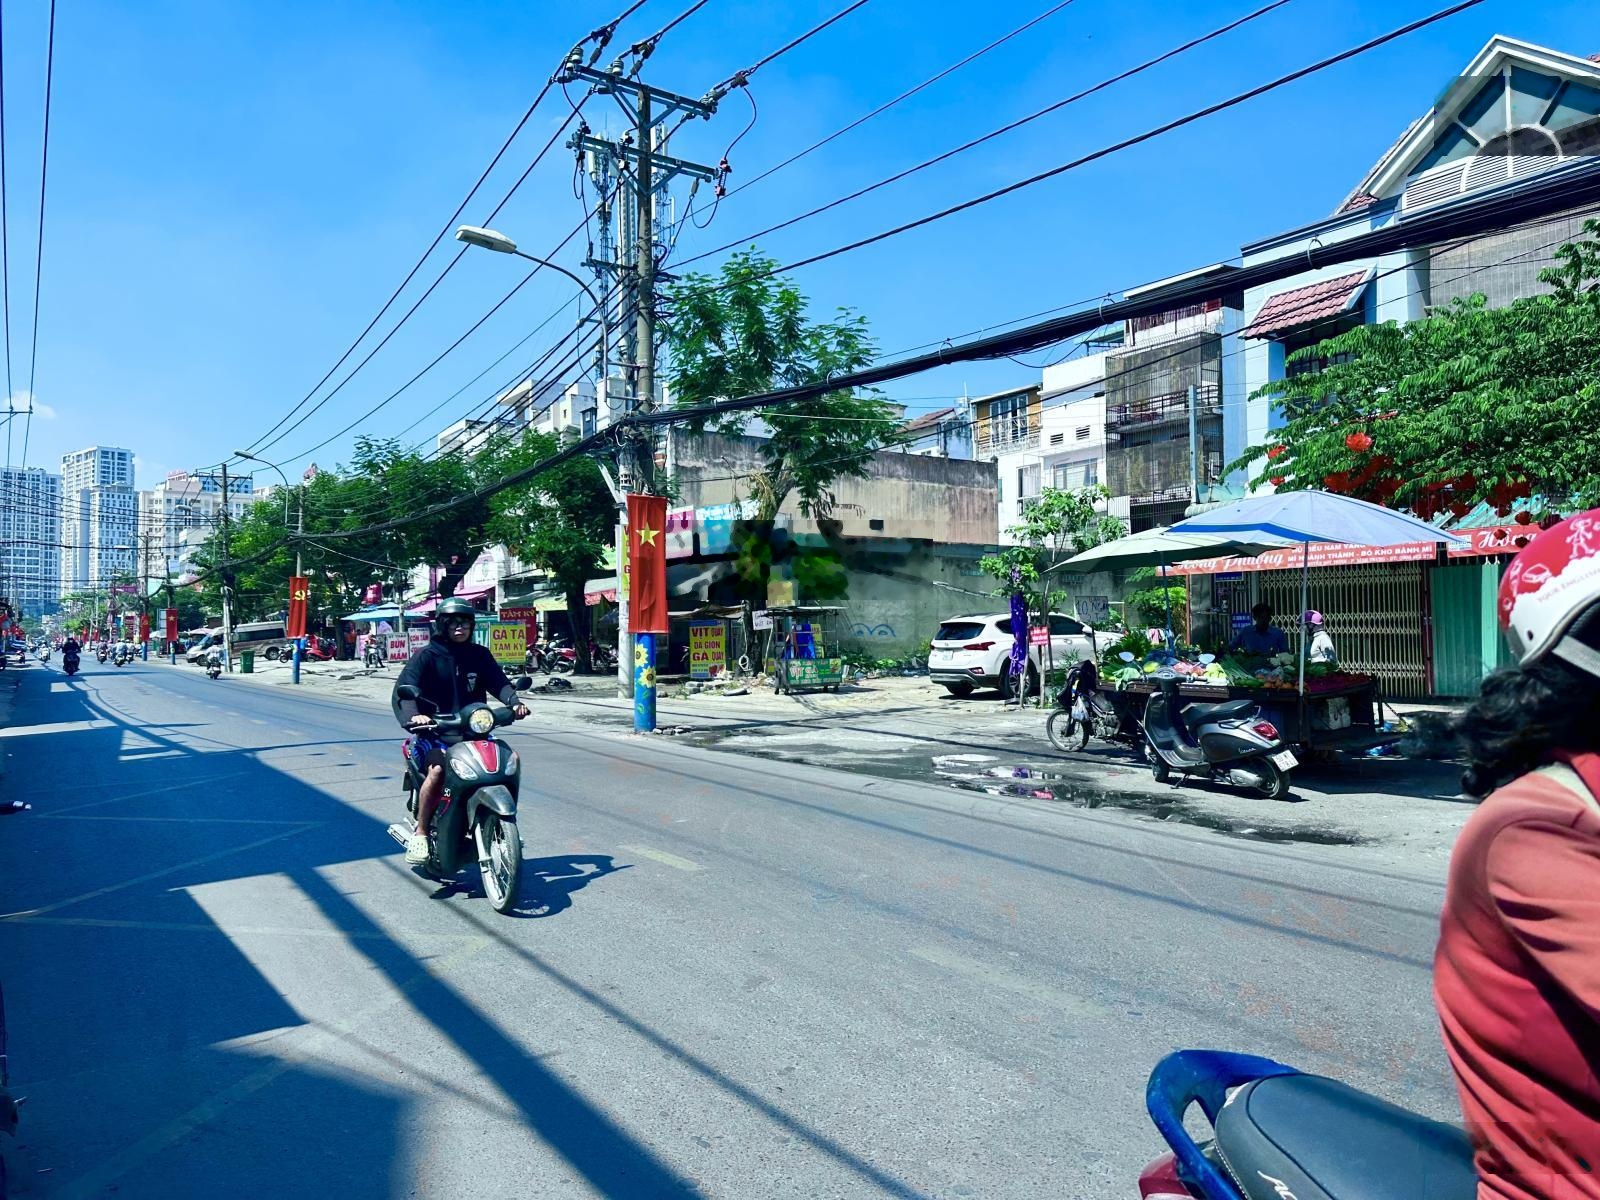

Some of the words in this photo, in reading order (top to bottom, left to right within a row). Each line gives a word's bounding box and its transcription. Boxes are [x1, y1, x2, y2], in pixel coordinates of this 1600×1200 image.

[1299, 552, 1325, 561] HÀNH
[493, 626, 507, 640] GÀ
[510, 629, 525, 640] TA
[692, 627, 709, 639] VỊT
[692, 650, 709, 661] GÀ
